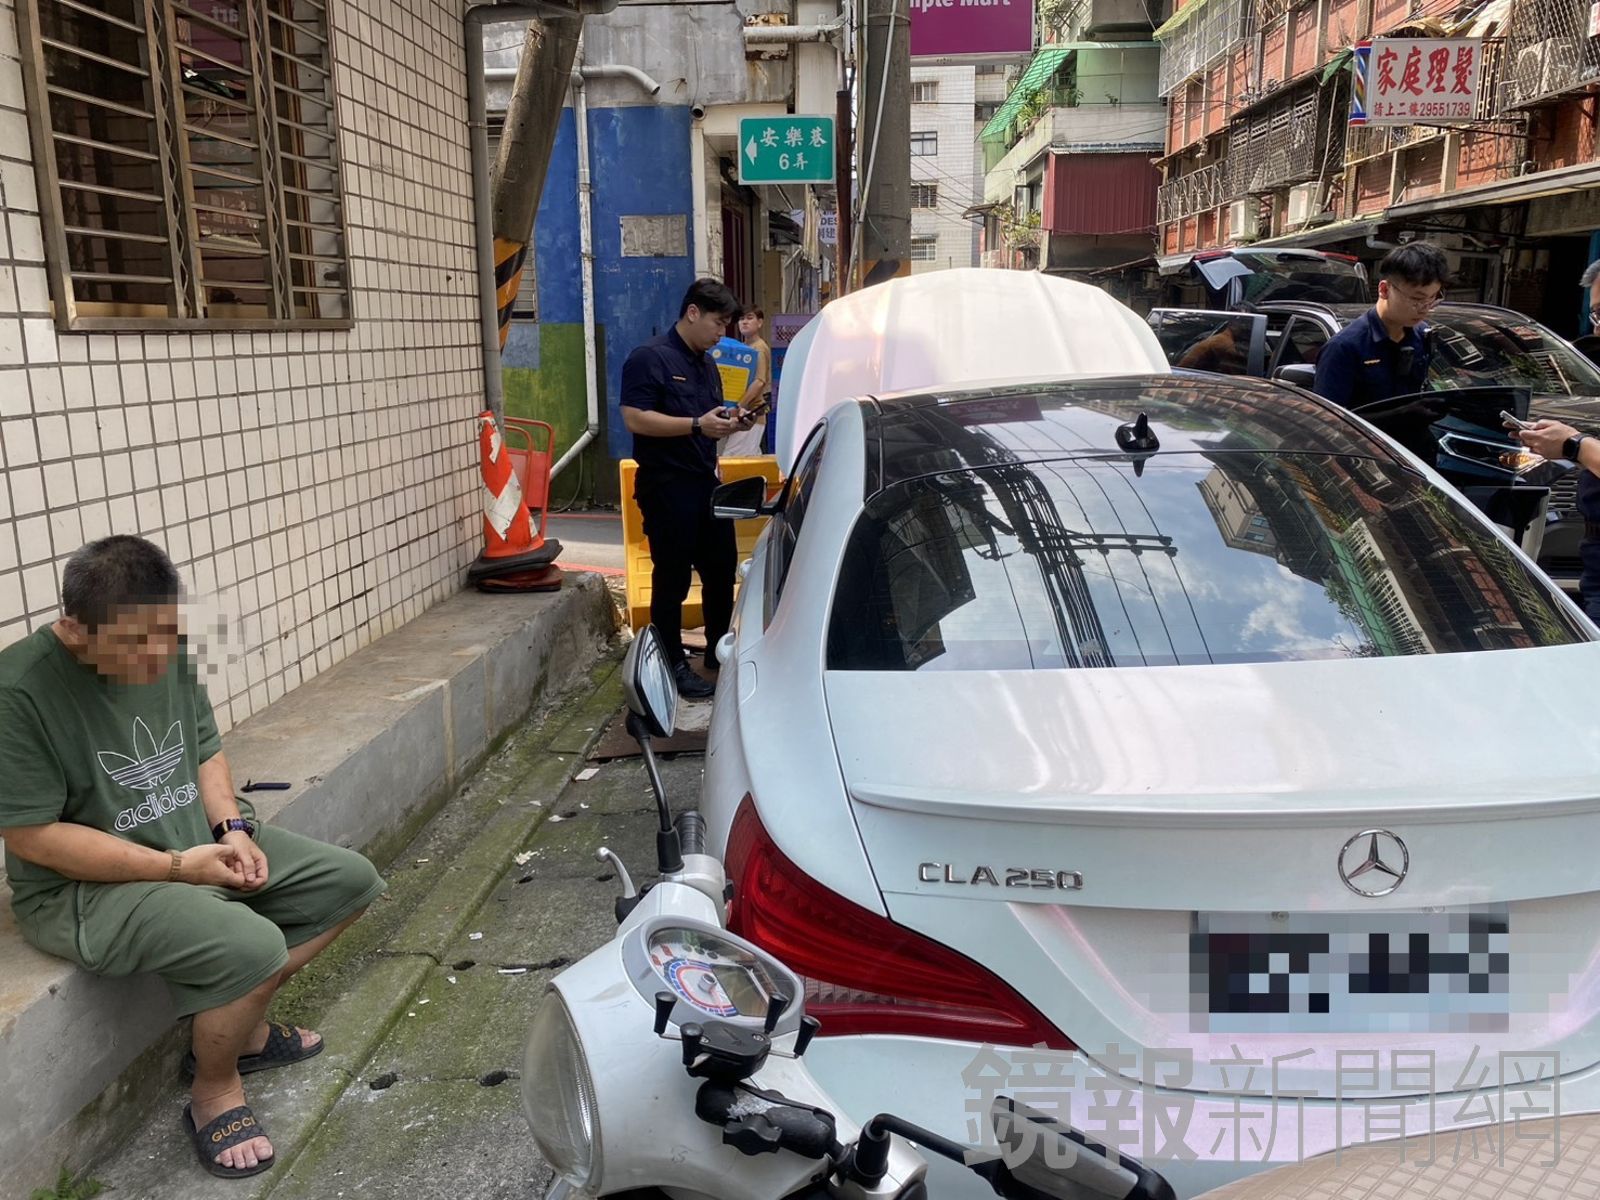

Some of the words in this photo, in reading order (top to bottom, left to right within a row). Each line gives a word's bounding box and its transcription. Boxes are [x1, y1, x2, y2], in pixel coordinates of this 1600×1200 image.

[1377, 45, 1473, 96] 家庭理髮
[760, 126, 828, 148] 安樂巷
[778, 152, 809, 171] 6弄
[114, 782, 198, 832] adidas
[211, 1116, 257, 1142] GUCCI
